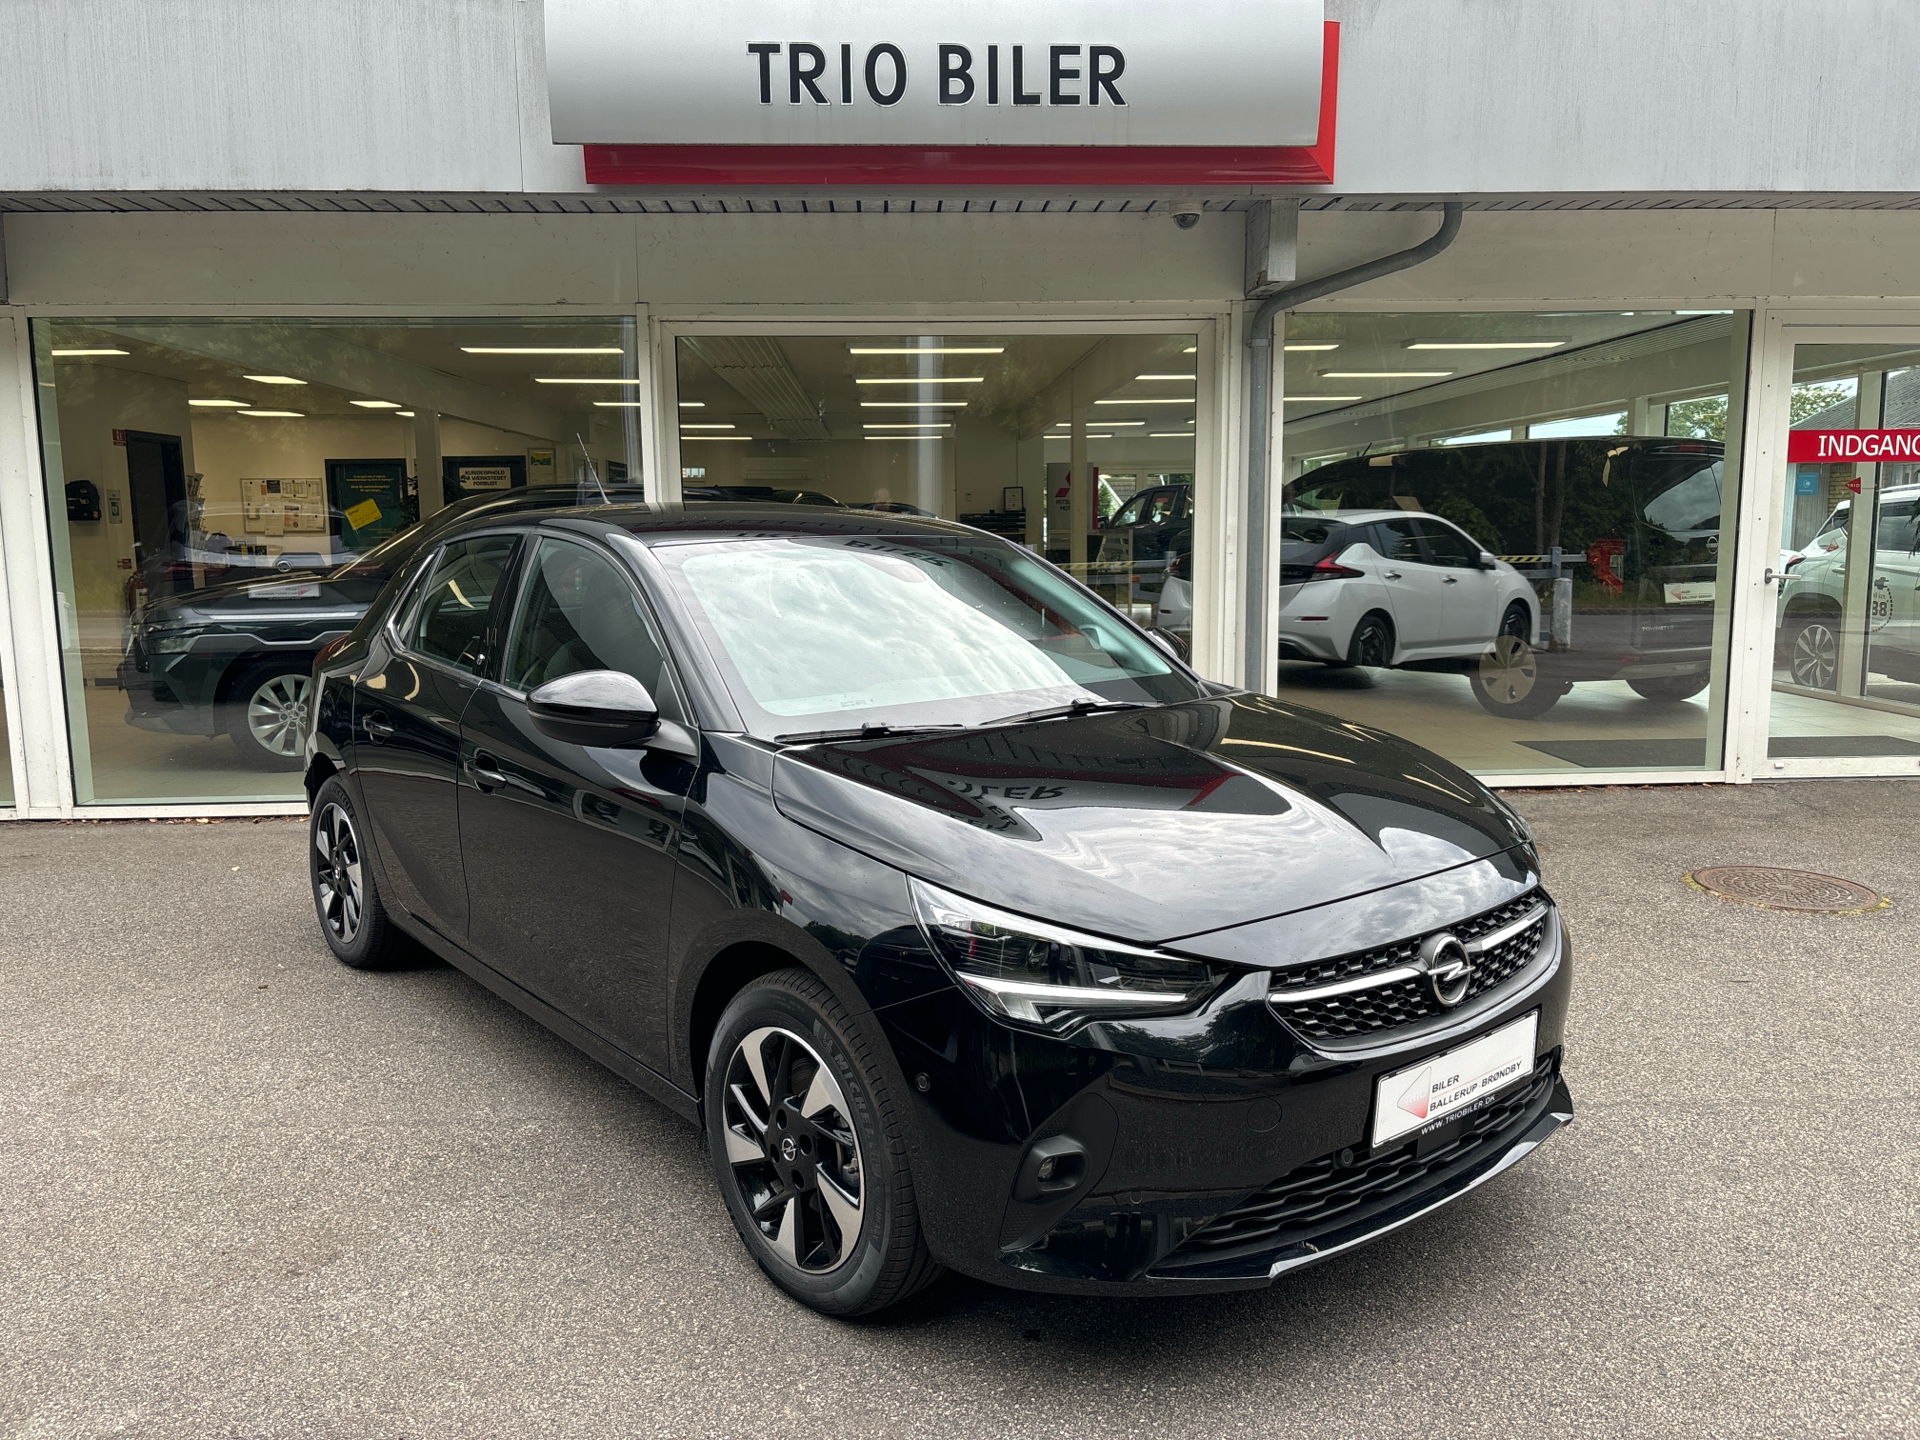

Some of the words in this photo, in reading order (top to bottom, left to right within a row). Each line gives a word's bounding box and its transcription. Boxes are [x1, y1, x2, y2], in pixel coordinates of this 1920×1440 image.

[746, 41, 909, 107] TRIO
[937, 43, 1130, 107] BILER
[1429, 1083, 1478, 1112] BALLERUP
[1481, 1060, 1522, 1088] BRØNDBY
[1431, 1074, 1460, 1093] BILER
[1421, 1094, 1496, 1135] WWW.TRIOBILER.DK
